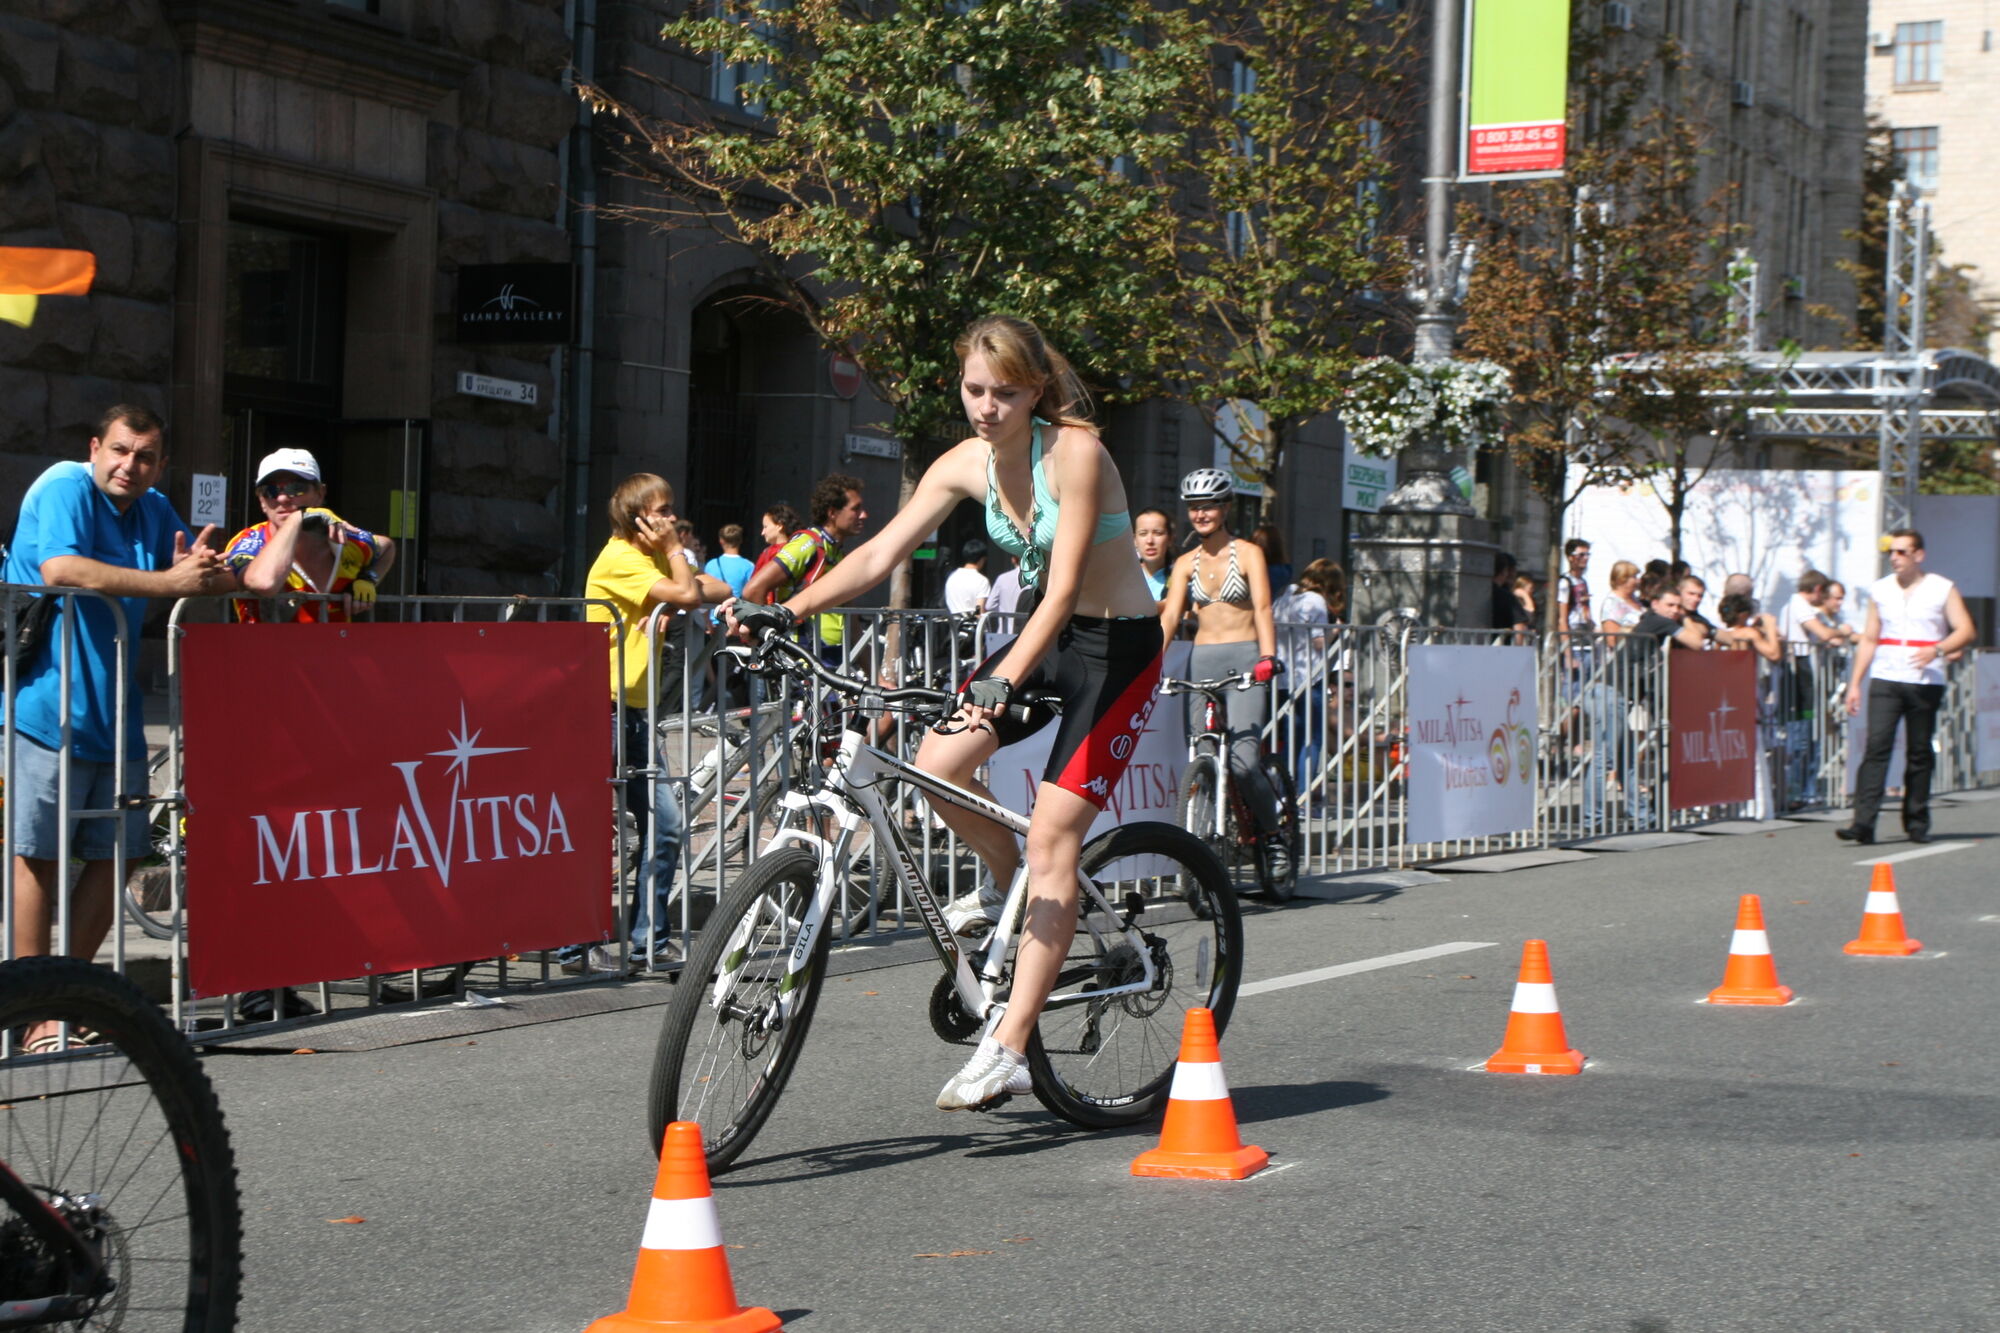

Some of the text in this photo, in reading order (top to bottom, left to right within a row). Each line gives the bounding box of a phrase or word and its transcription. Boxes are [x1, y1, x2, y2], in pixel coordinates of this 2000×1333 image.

[1486, 131, 1508, 143] 800
[1509, 129, 1524, 142] 30
[1526, 128, 1540, 140] 45
[1542, 127, 1558, 139] 45
[463, 311, 563, 322] GRAND GALLERY
[520, 384, 534, 400] 34
[1417, 704, 1484, 748] MILAVITSA
[1681, 711, 1748, 769] MILAVITSA
[250, 761, 576, 888] MILAVITSA
[794, 923, 814, 960] GILA
